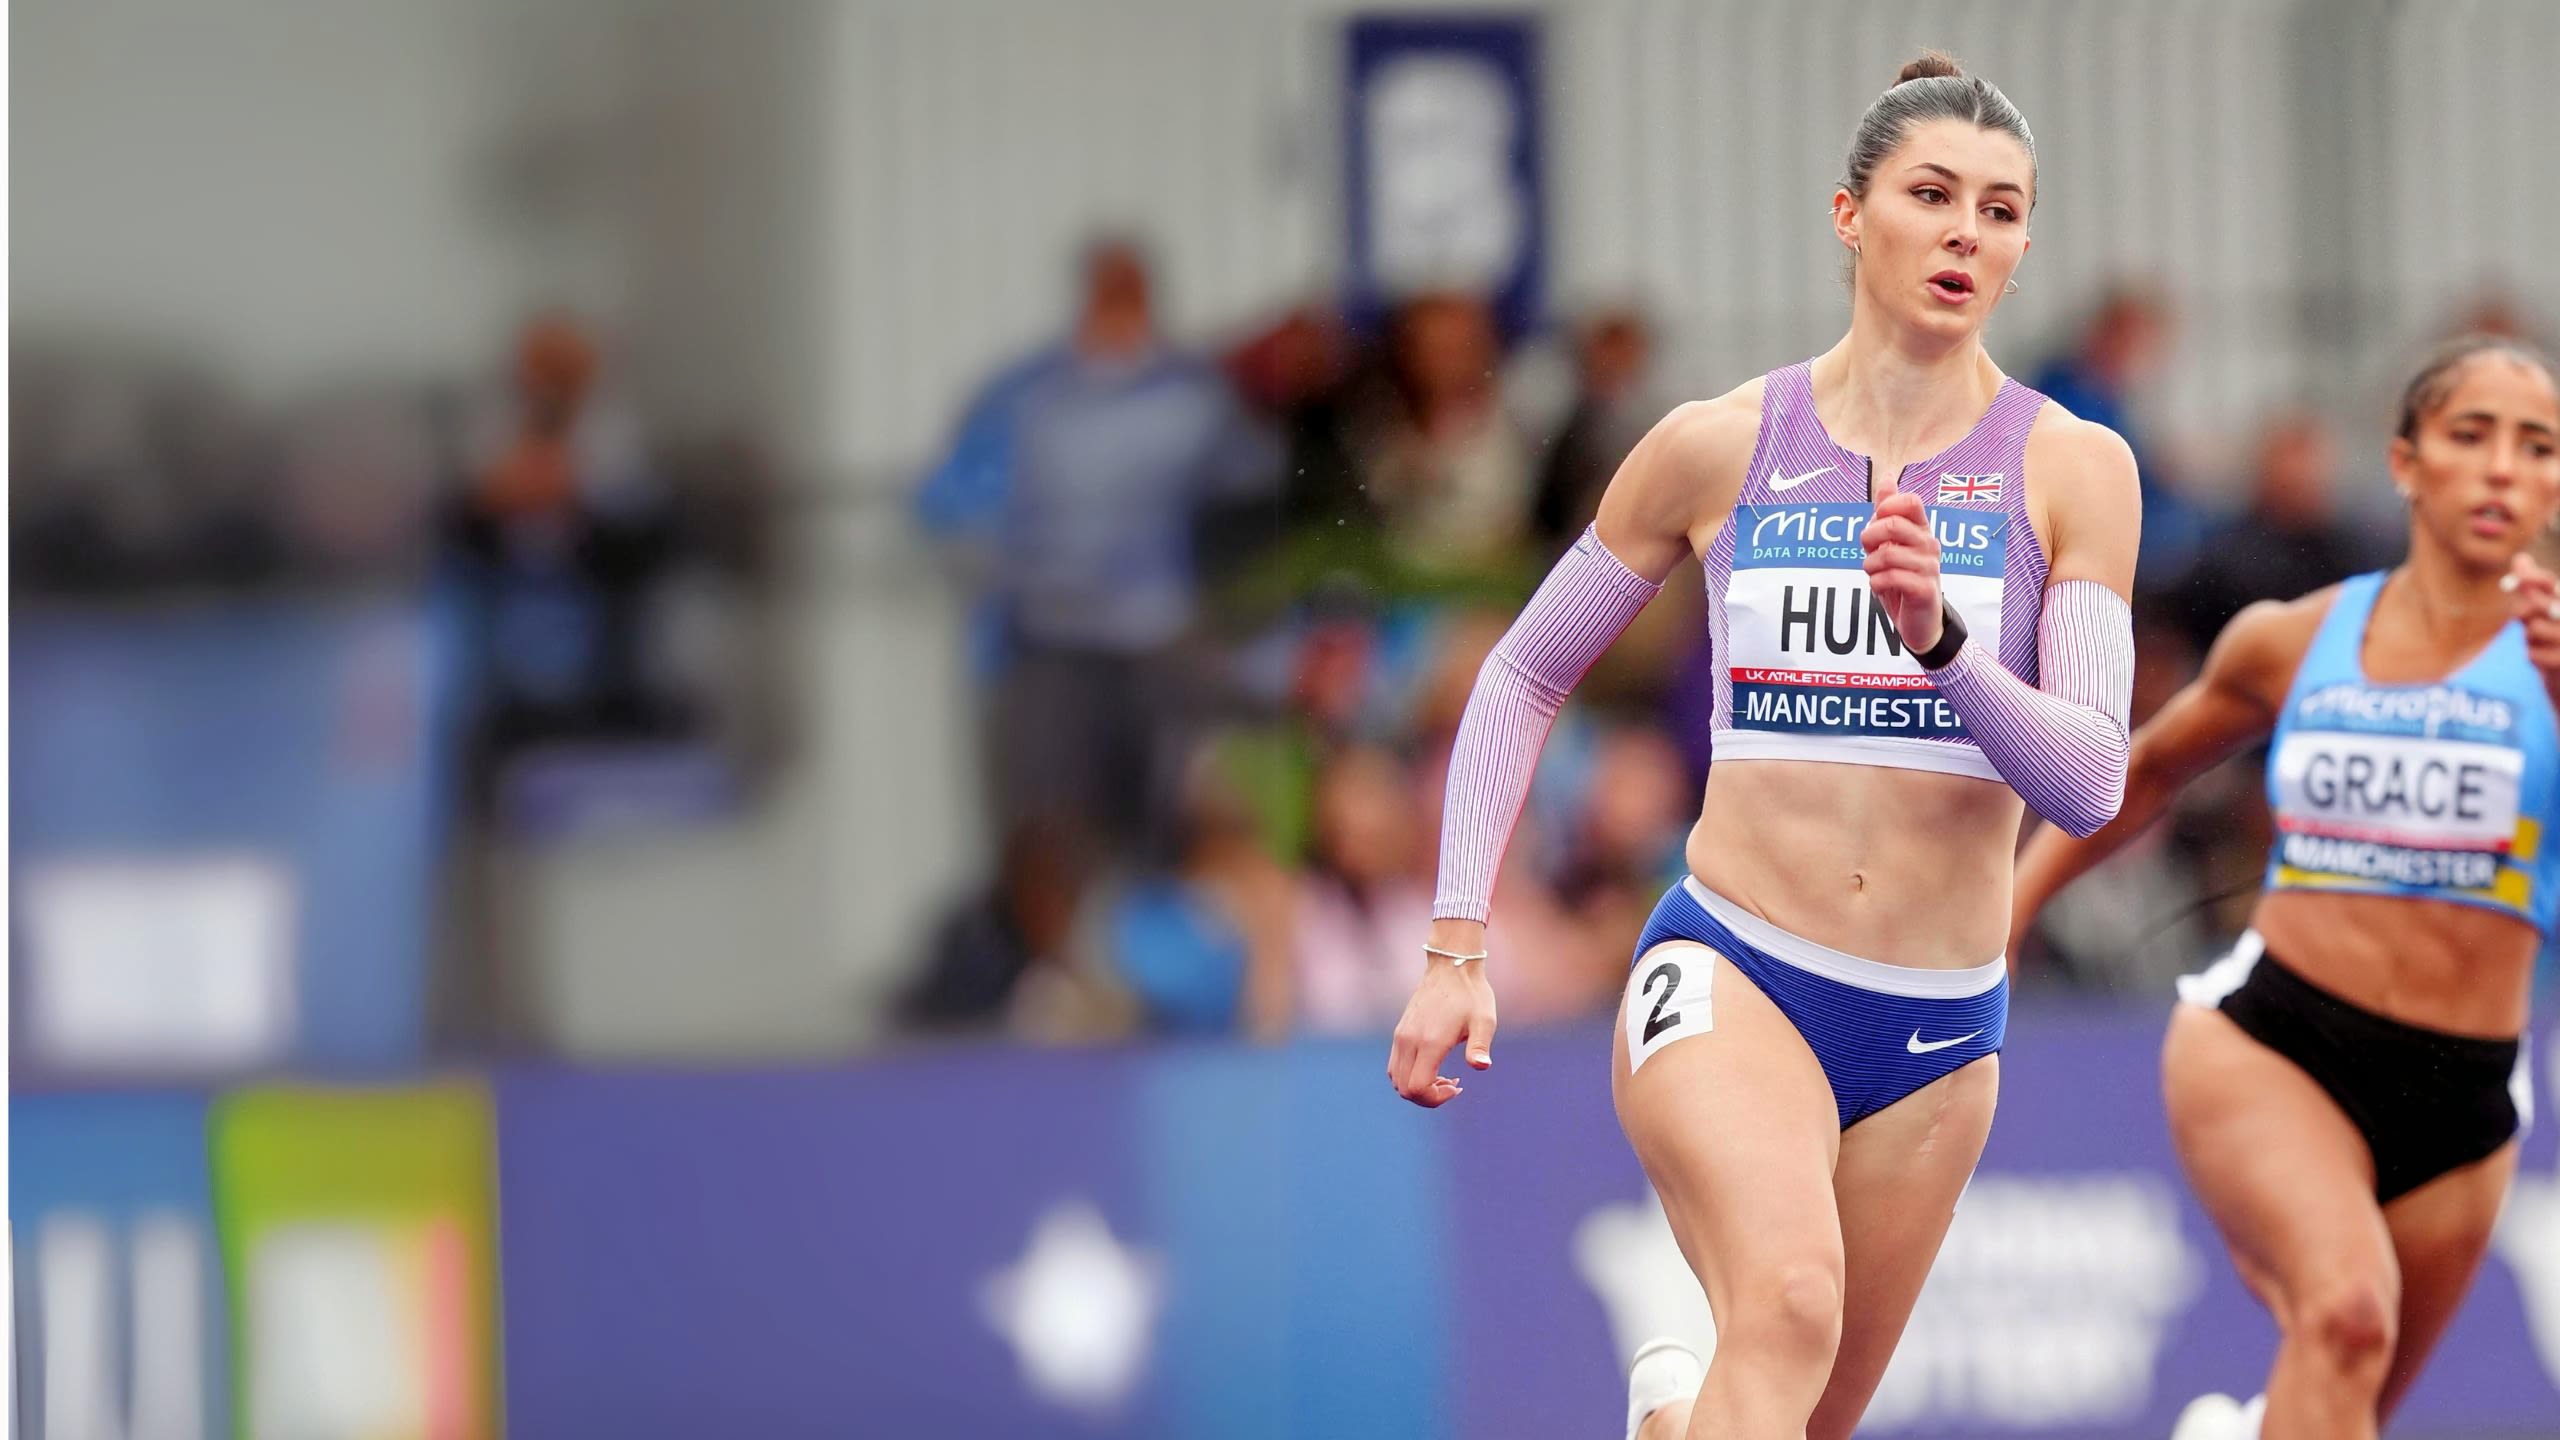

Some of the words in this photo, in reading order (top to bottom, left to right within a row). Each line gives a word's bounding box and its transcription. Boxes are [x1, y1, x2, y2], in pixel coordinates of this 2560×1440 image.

[1753, 546, 1791, 559] DATA
[1797, 546, 1868, 560] PROCESS
[1940, 552, 1984, 567] MING
[1781, 585, 1901, 657] HUN
[1745, 670, 1765, 681] UK
[1767, 671, 1846, 685] ATHLETICS
[1850, 675, 1935, 687] CHAMPION
[1746, 691, 1961, 728] MANCHESTE
[2303, 752, 2486, 820] GRACE
[2284, 834, 2496, 887] MANCHESTER
[1641, 961, 1683, 1048] 2
